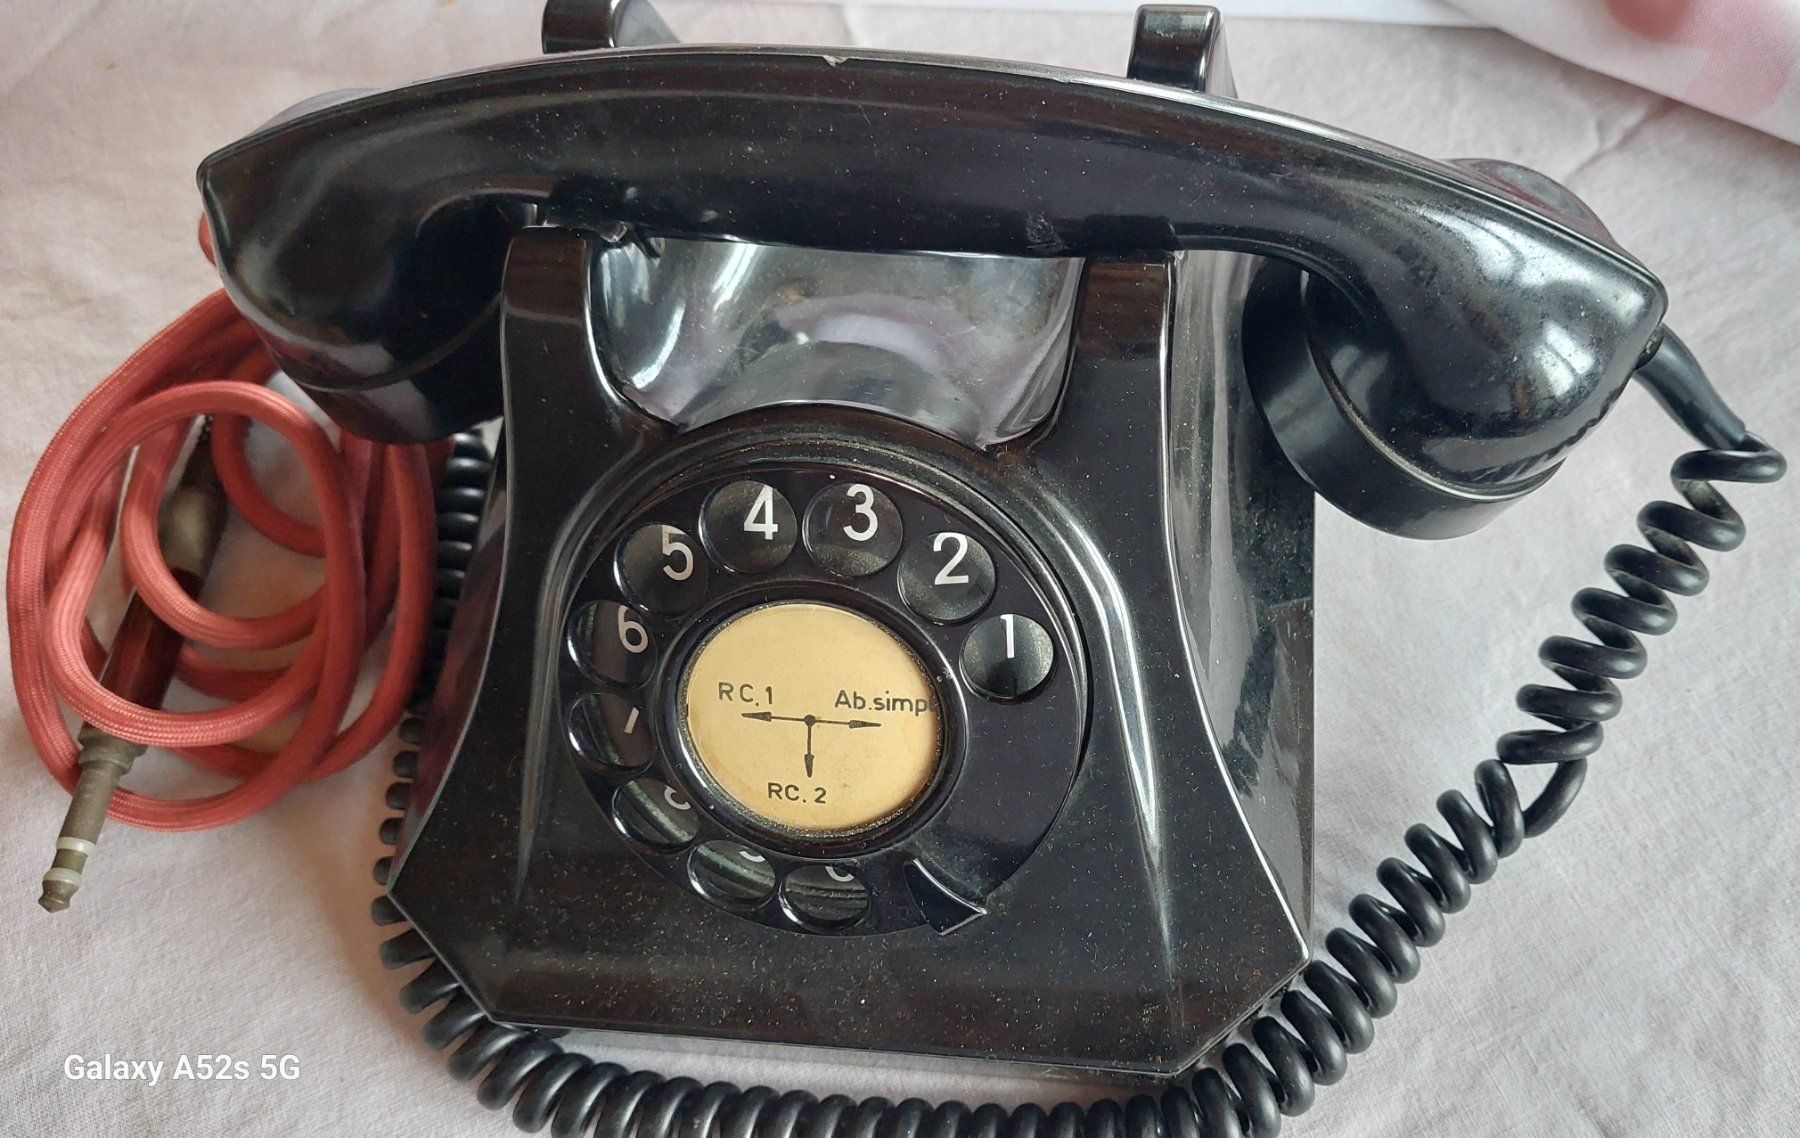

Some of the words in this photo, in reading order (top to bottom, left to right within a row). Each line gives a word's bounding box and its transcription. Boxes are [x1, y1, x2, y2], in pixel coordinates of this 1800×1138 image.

[743, 484, 779, 540] 4
[843, 483, 879, 541] 3
[661, 524, 694, 581] 5
[933, 532, 969, 586] 2
[617, 604, 649, 653] 6
[1000, 613, 1015, 659] 1
